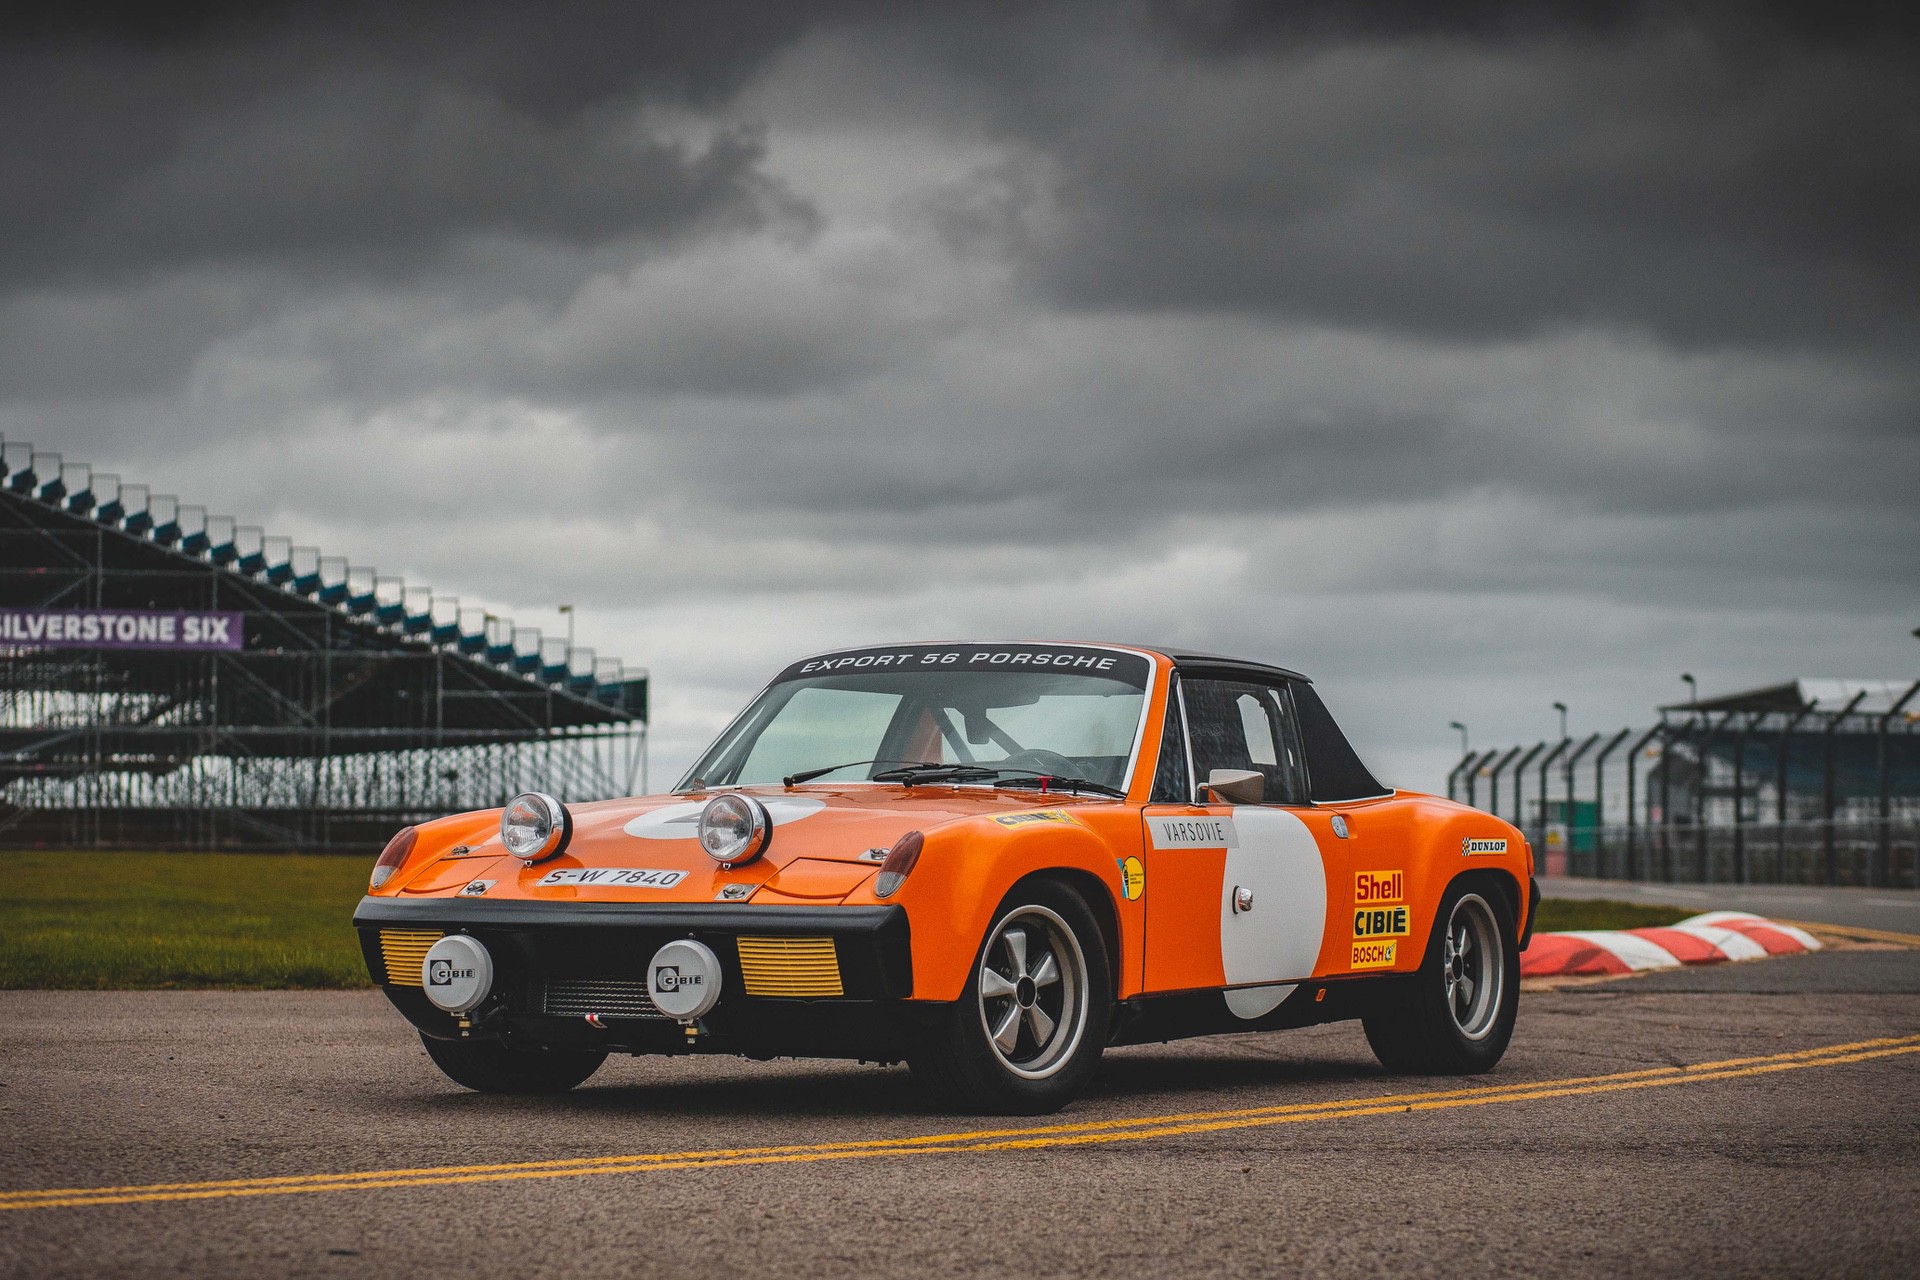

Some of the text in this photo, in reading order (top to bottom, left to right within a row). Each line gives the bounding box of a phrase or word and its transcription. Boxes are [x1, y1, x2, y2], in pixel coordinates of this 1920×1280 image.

[0, 613, 230, 643] ILVERSTONE SIX
[800, 653, 1118, 673] EXPORT 56 PORSCHE
[1163, 822, 1224, 841] VARSOVIE
[1471, 841, 1506, 851] DUNLOP
[544, 870, 681, 886] S-W 7840
[1357, 873, 1402, 900] Shell
[1353, 946, 1385, 963] BOSCH
